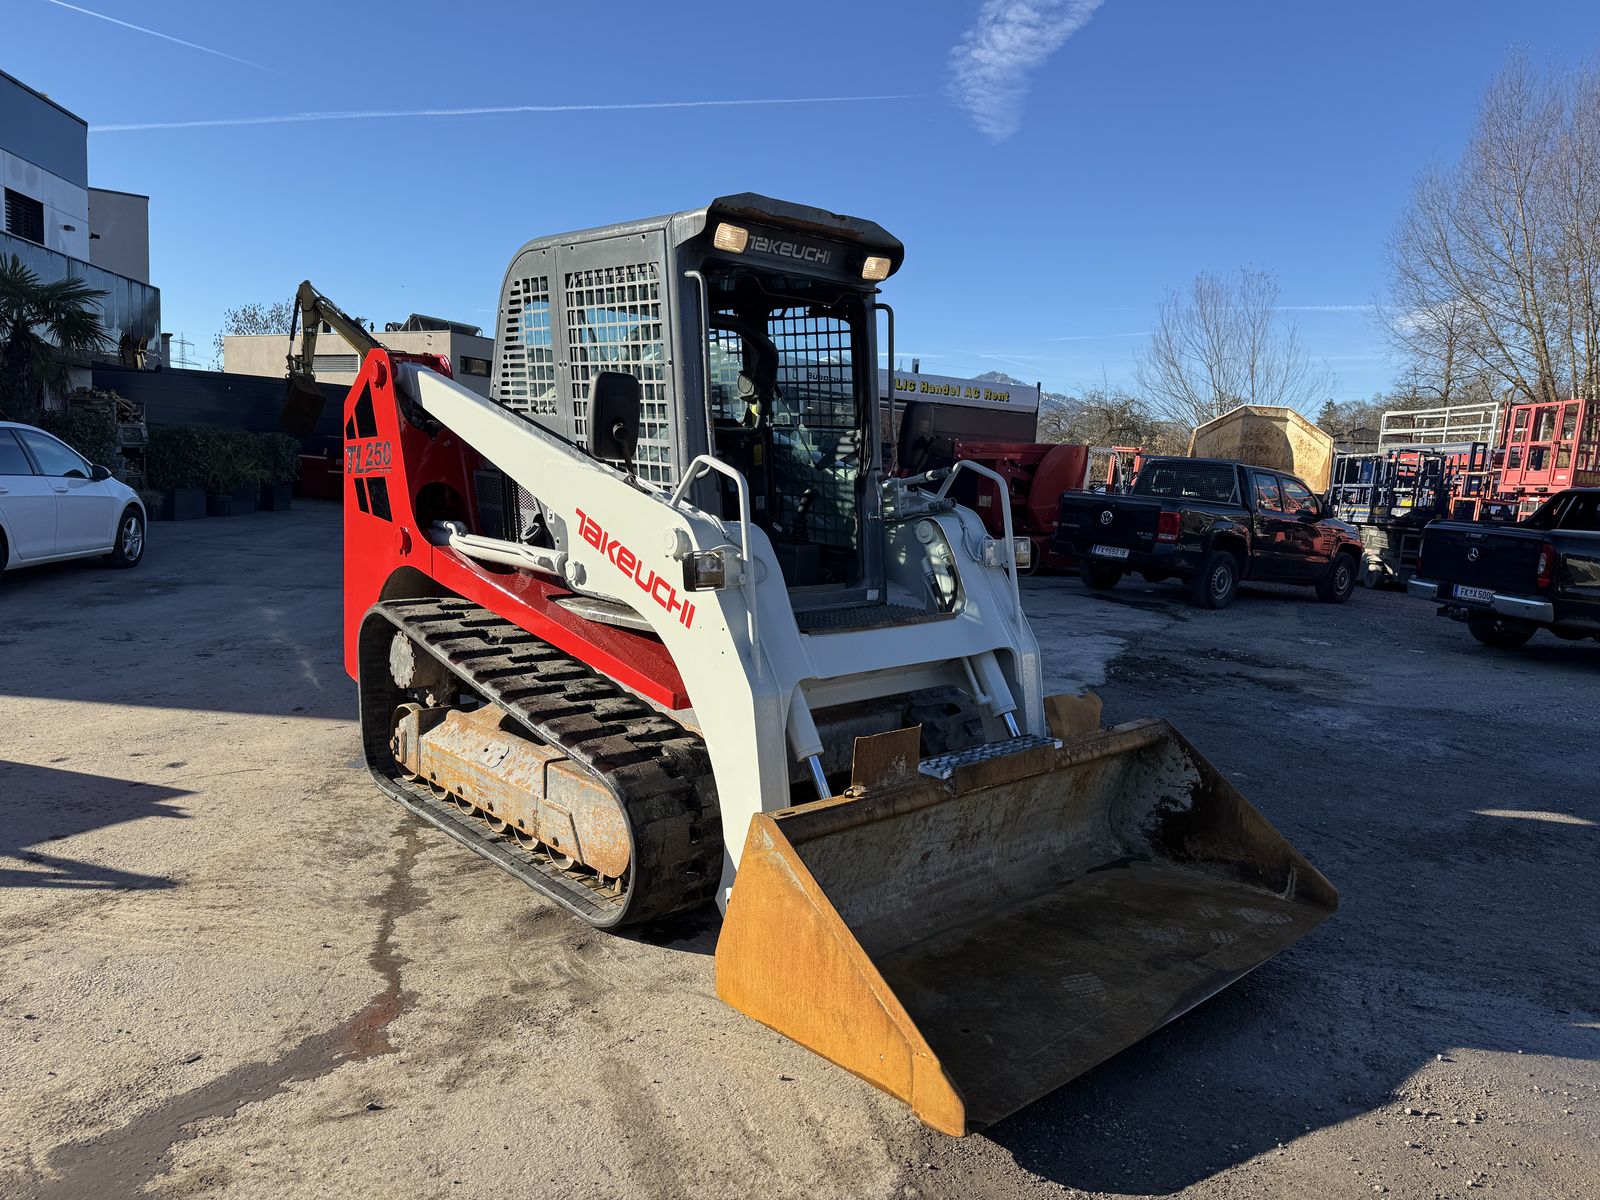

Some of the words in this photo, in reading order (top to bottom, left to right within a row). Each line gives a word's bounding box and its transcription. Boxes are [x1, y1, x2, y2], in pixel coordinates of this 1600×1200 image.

[920, 380, 961, 397] Handel
[984, 388, 1010, 402] Rent
[575, 507, 697, 630] TAKEUCHI
